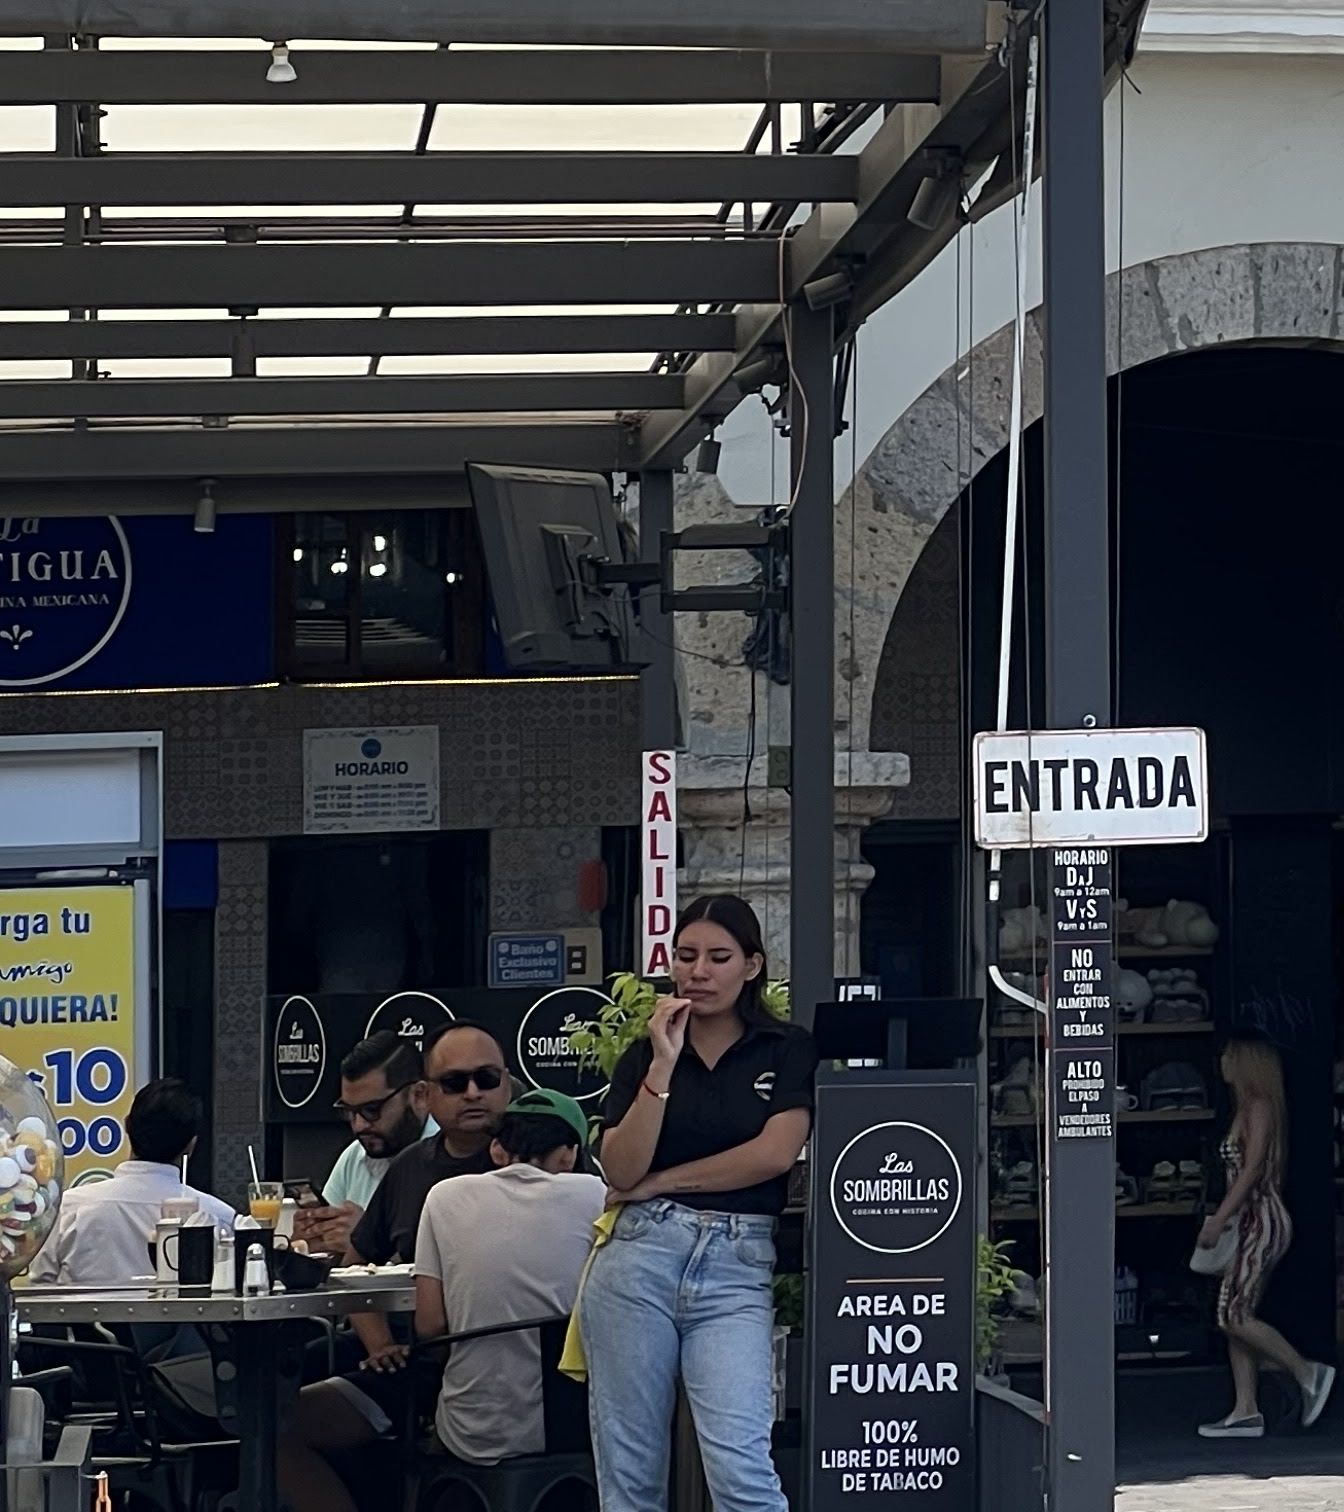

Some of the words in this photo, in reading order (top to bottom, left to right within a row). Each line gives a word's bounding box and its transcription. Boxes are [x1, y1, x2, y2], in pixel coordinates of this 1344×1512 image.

[0, 549, 119, 582] IGUA
[32, 594, 110, 607] MEXICANA
[335, 761, 409, 777] HORARIO
[985, 755, 1197, 814] ENTRADA
[647, 752, 672, 976] SALIDA
[1054, 849, 1108, 866] HORARIO
[1054, 887, 1075, 897] 9am
[1085, 887, 1110, 896] 12am
[61, 907, 90, 934] tu
[1057, 921, 1078, 931] 9am
[1088, 920, 1108, 929] 1am
[498, 956, 557, 968] Exclusivo
[1071, 948, 1093, 968] NO
[501, 969, 554, 980] Clientes
[1063, 968, 1102, 982] ENTRAR
[1073, 982, 1093, 995] CON
[0, 994, 118, 1028] QUIERA!
[1056, 996, 1110, 1009] ALIMENTOS
[1079, 1010, 1087, 1023] Y
[398, 1017, 424, 1036] Las
[1063, 1023, 1104, 1037] BEBIDAS
[1067, 1060, 1102, 1079] ALTO
[1079, 1090, 1100, 1101] PASO
[1081, 1102, 1088, 1113] A
[1057, 1125, 1112, 1138] AMBULANTES
[879, 1152, 914, 1174] Las
[843, 1178, 949, 1202] SOMBRILLAS
[837, 1295, 905, 1317] AREA
[913, 1294, 945, 1315] DE
[867, 1324, 923, 1355] NO
[829, 1362, 959, 1394] FUMAR
[862, 1420, 918, 1444] 100%
[821, 1449, 872, 1469] LIBRE
[876, 1448, 900, 1467] DE
[904, 1446, 960, 1467] HUMO
[842, 1473, 868, 1492] DE
[871, 1471, 943, 1491] TABACO
